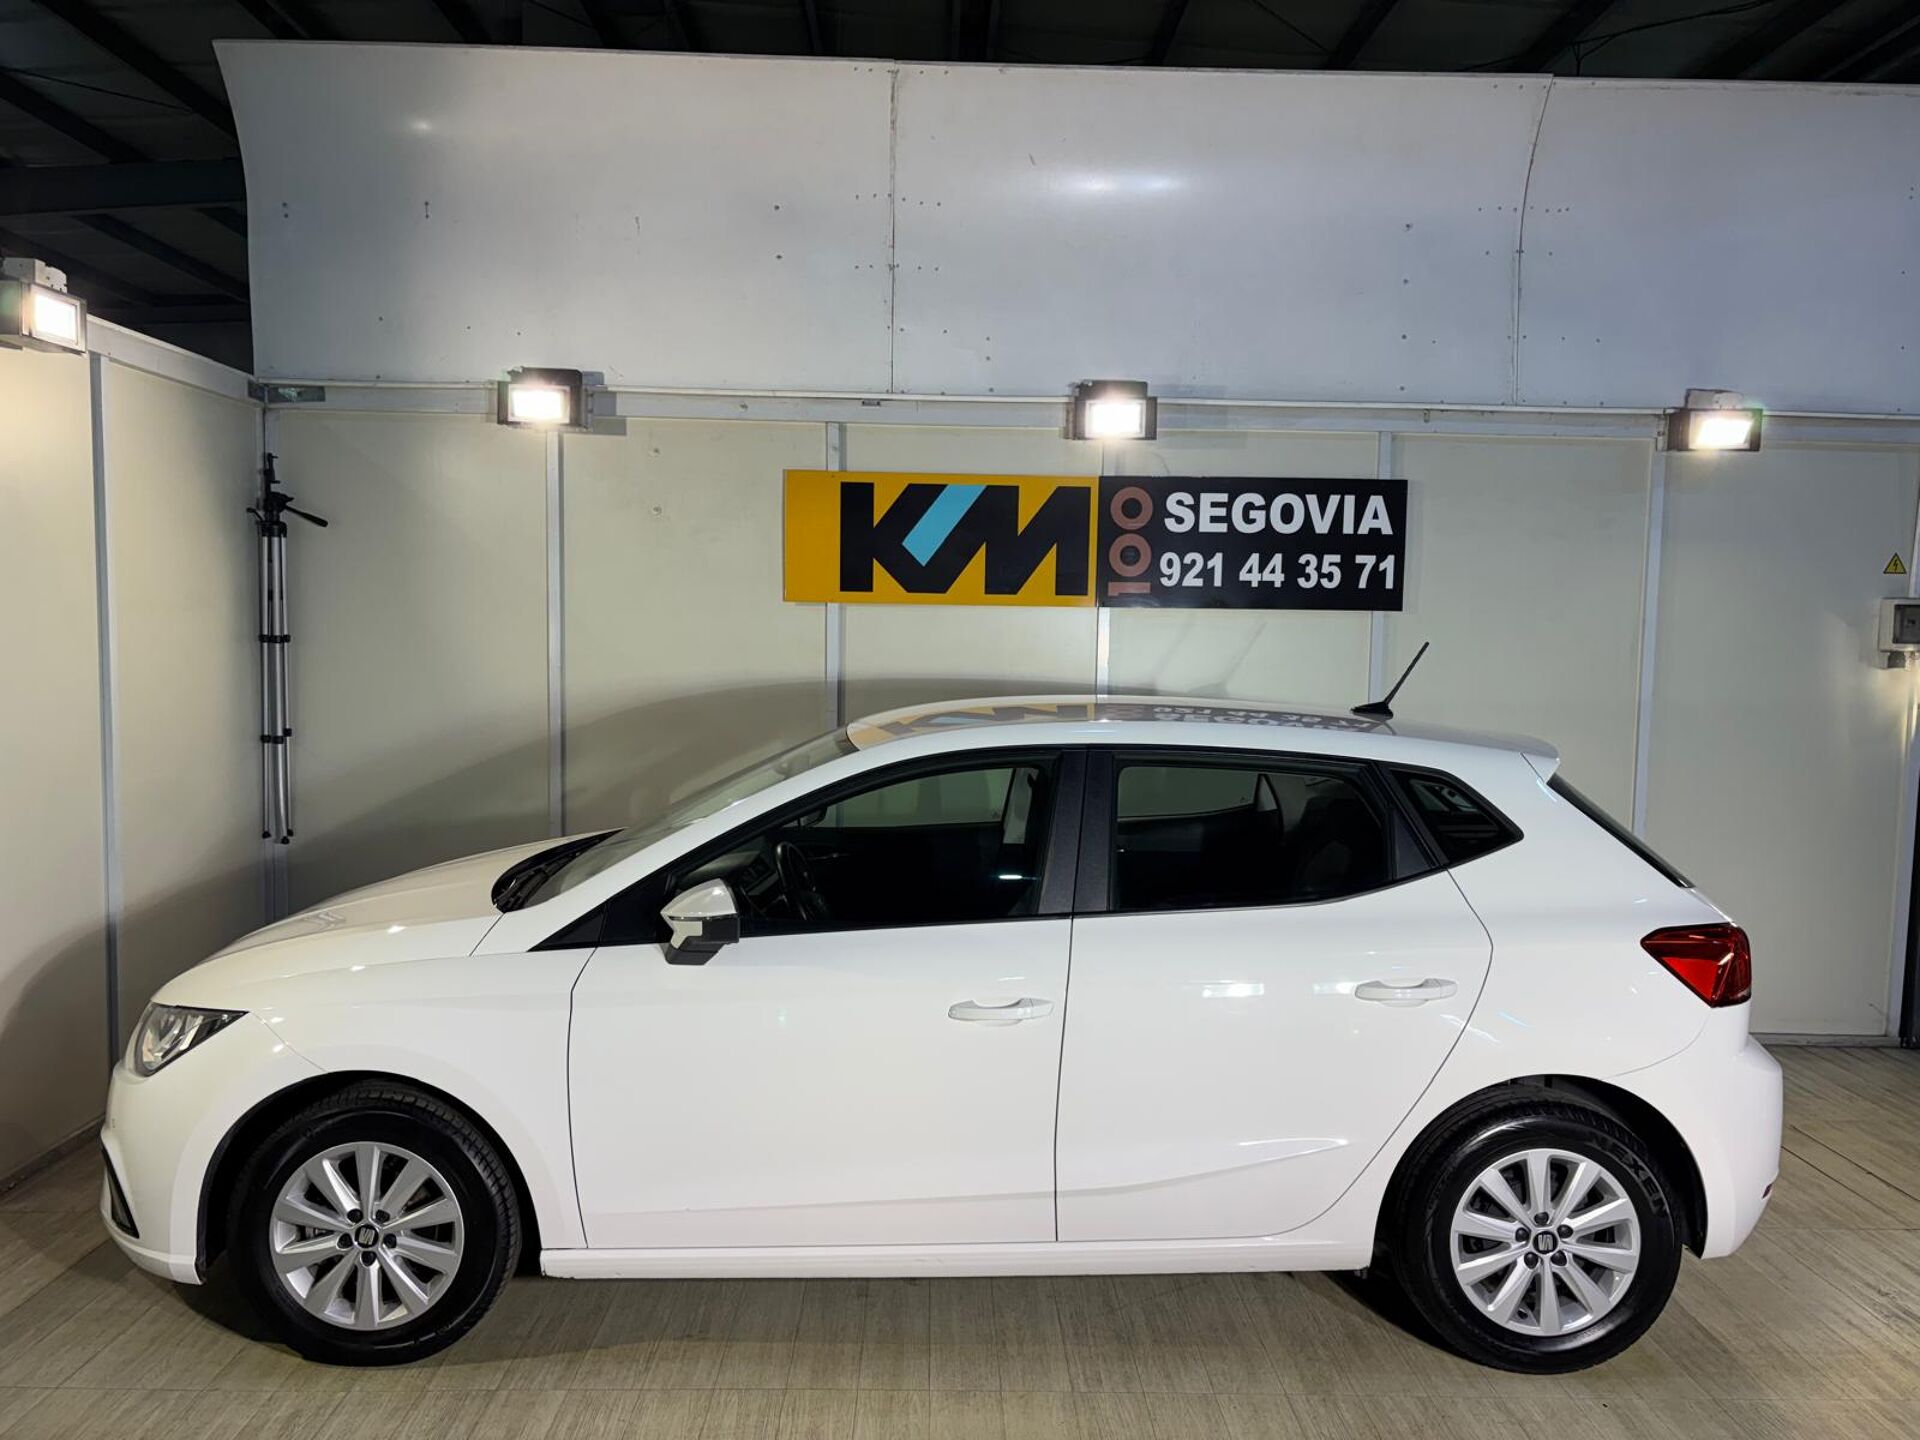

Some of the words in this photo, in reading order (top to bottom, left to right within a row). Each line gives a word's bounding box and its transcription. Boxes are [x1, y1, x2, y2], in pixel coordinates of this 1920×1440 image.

[840, 482, 1092, 596] KM
[1108, 486, 1153, 598] 100
[1164, 491, 1394, 535] SEGOVIA
[1159, 551, 1223, 587] 921
[1239, 552, 1285, 588] 44
[1297, 553, 1342, 589] 35
[1355, 554, 1395, 589] 71
[1589, 1134, 1668, 1217] NEXEN
